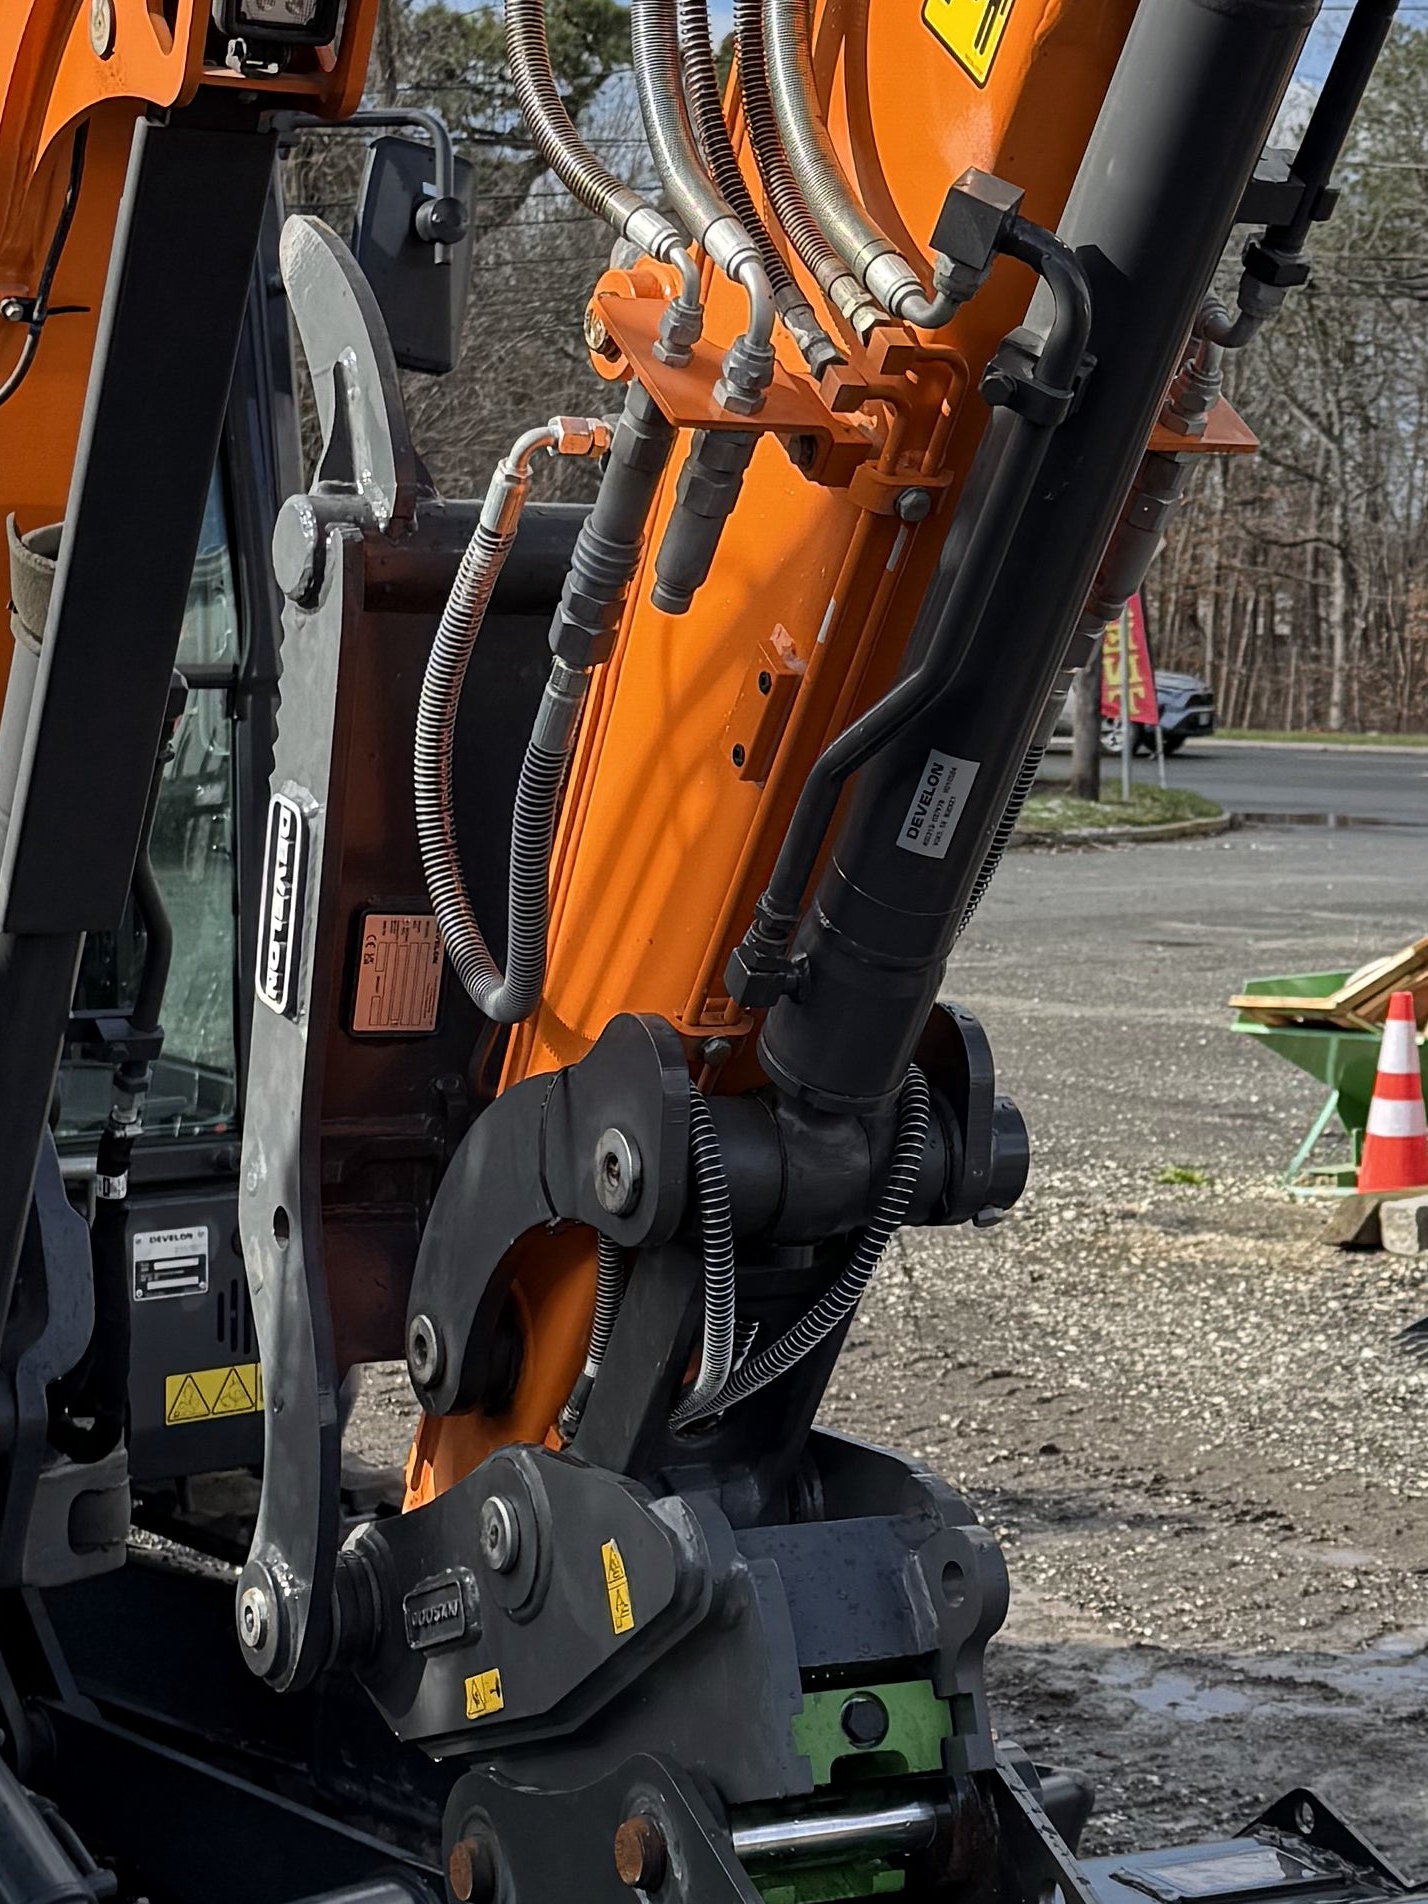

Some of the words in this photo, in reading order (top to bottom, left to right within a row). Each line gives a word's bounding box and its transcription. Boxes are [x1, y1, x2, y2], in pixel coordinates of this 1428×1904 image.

[907, 762, 945, 840] DEVELON
[265, 804, 294, 1004] DEVELON
[149, 1232, 194, 1244] DEVELON
